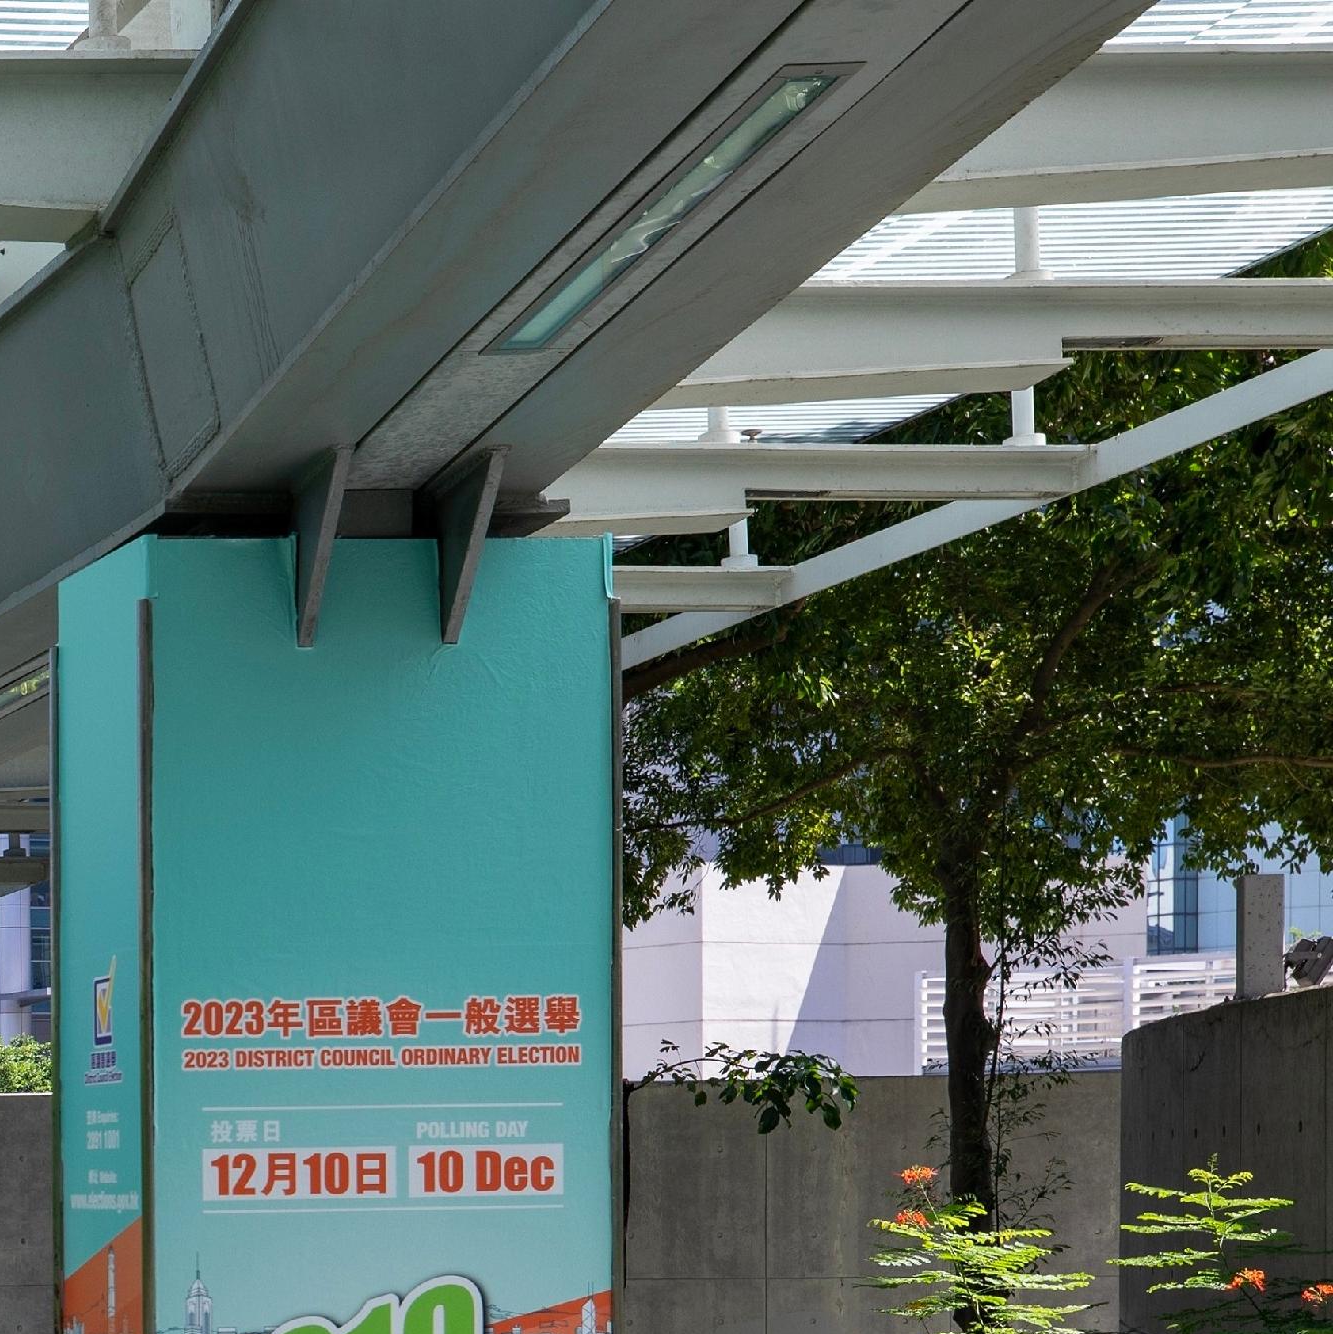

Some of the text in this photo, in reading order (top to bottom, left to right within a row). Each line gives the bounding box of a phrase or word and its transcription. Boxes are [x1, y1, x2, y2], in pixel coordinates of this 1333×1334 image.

[183, 996, 580, 1036] 2023年區議會一般選舉
[183, 1045, 580, 1069] 2023 DISTRICT COUNCIL ORDINARY ELECTION
[210, 1120, 281, 1143] 投票日
[416, 1120, 528, 1140] POLLING DAY
[211, 1152, 387, 1196] 12月10日
[416, 1150, 555, 1193] 10 Dec
